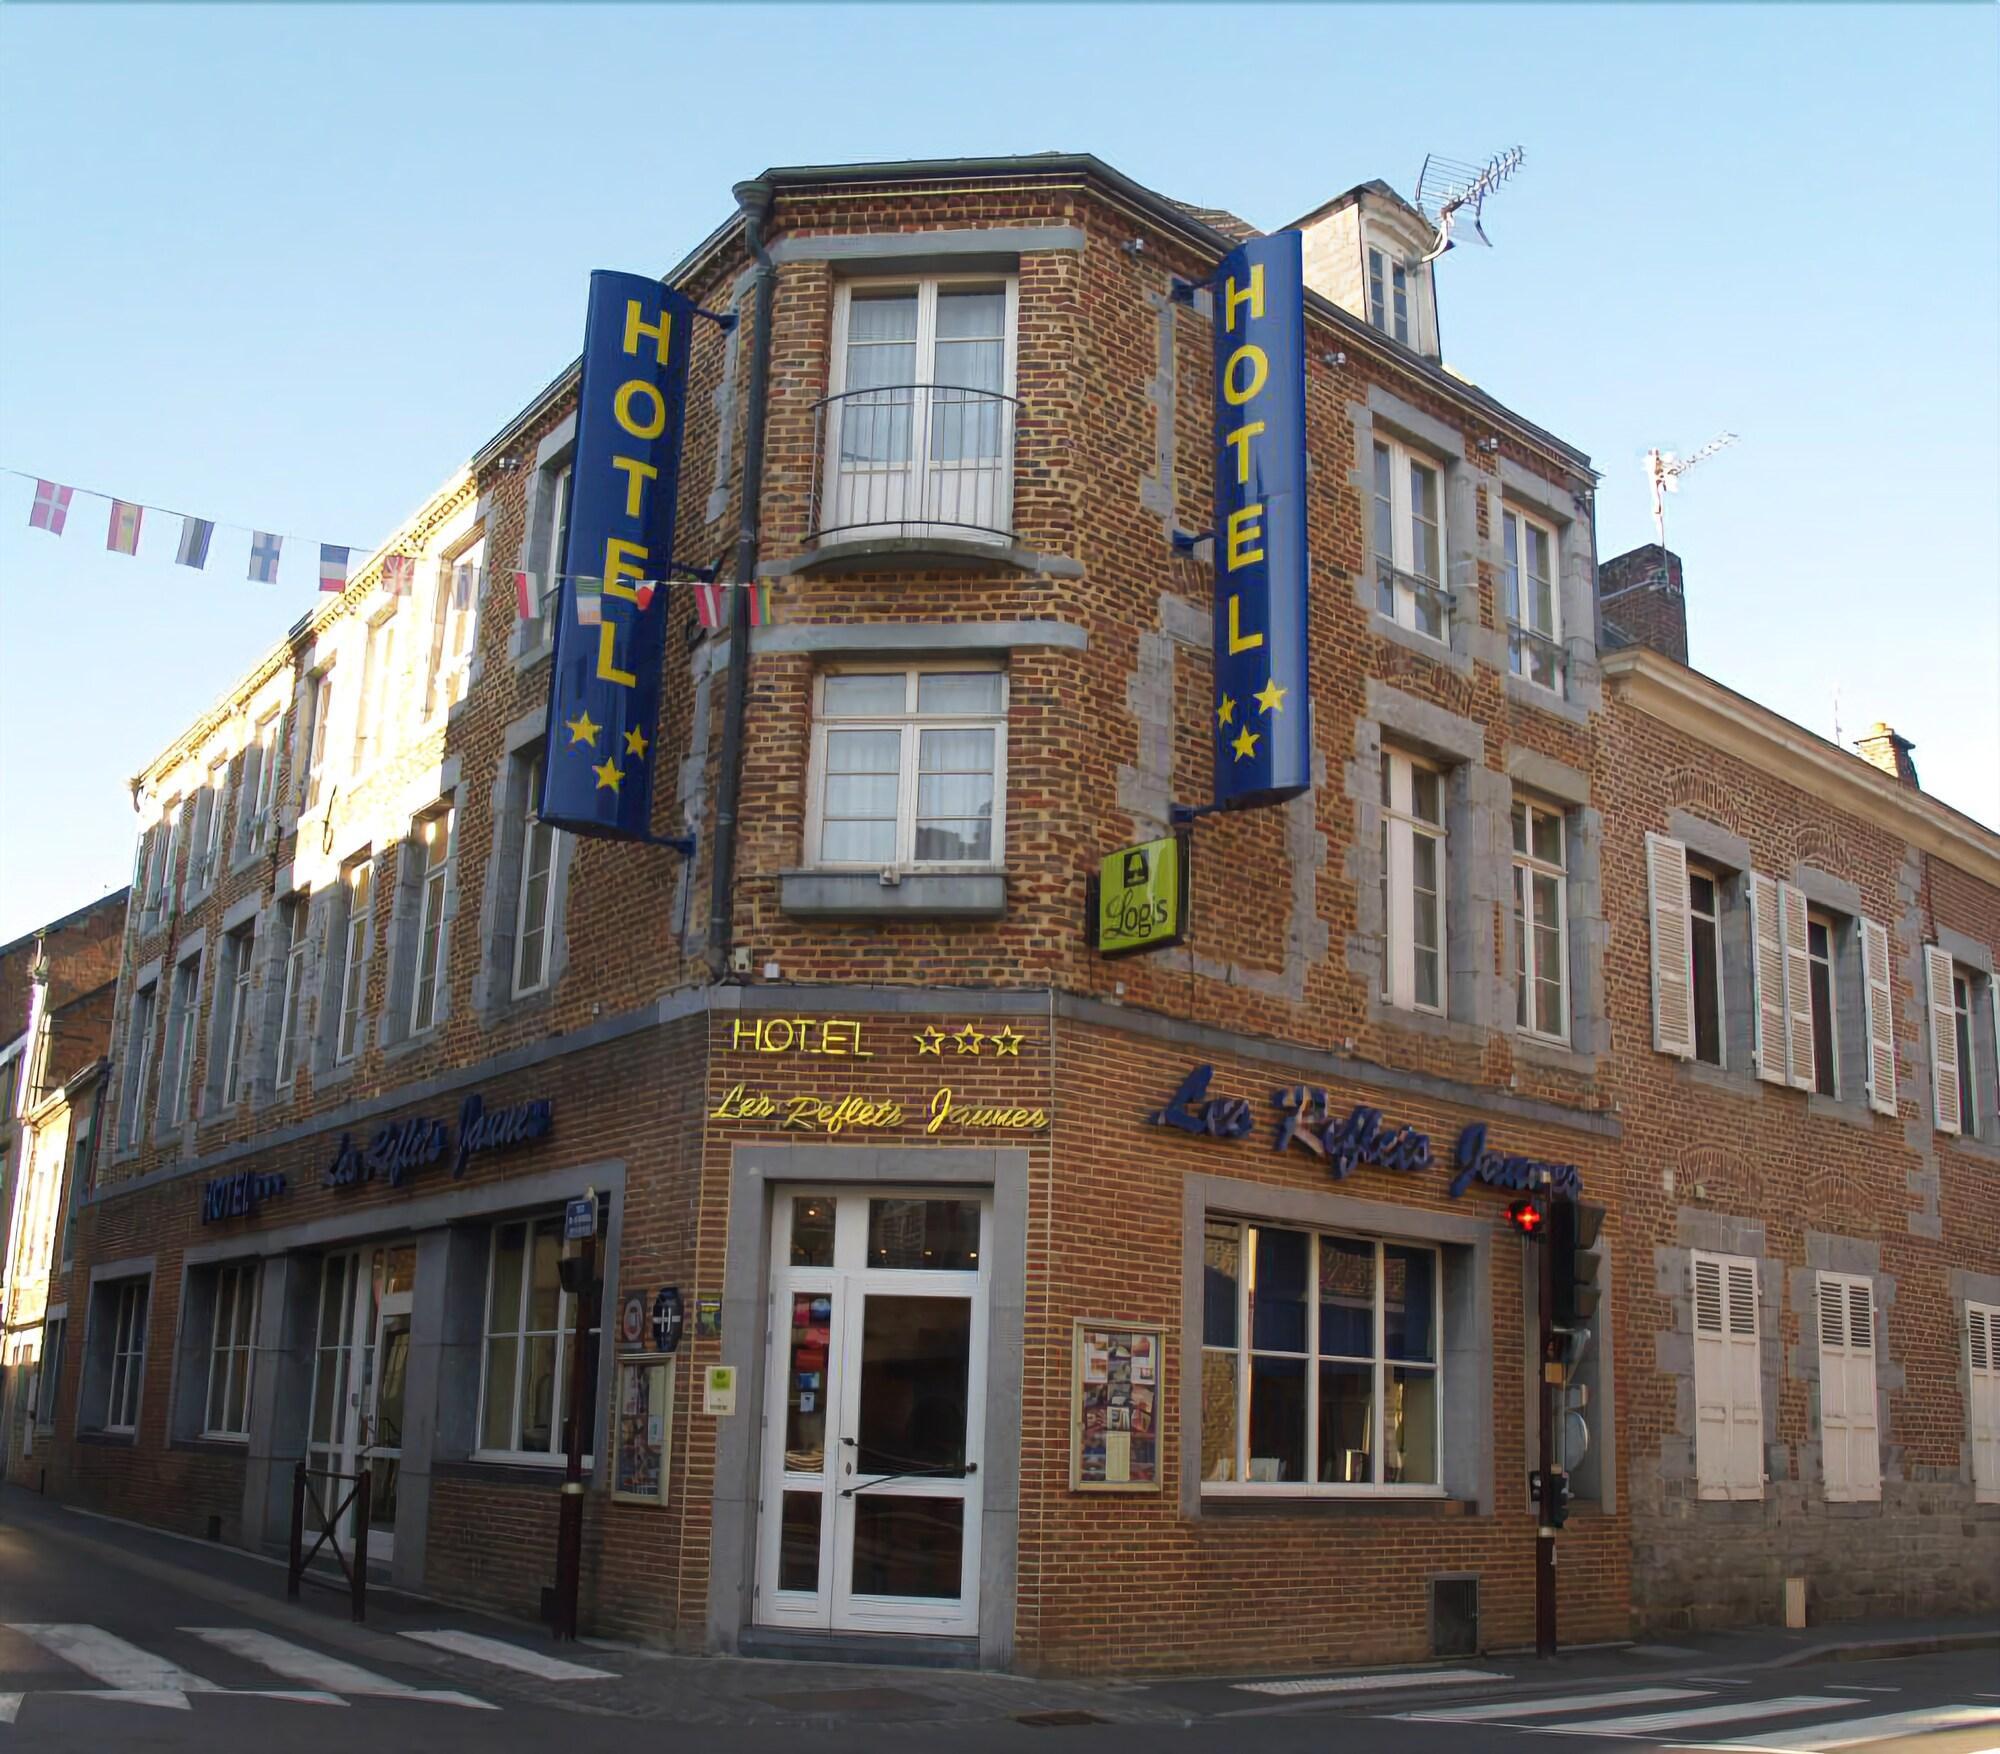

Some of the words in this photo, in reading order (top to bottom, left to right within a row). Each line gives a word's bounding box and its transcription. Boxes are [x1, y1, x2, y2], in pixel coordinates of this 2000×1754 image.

[1223, 264, 1270, 656] HOTEL
[596, 300, 672, 688] HOTEL
[1104, 888, 1168, 939] Logis
[733, 1019, 875, 1056] HOTEL
[709, 1083, 775, 1119] Les
[783, 1096, 905, 1134] Reflets
[926, 1087, 1050, 1134] Jaunes
[1147, 1064, 1253, 1138] Les
